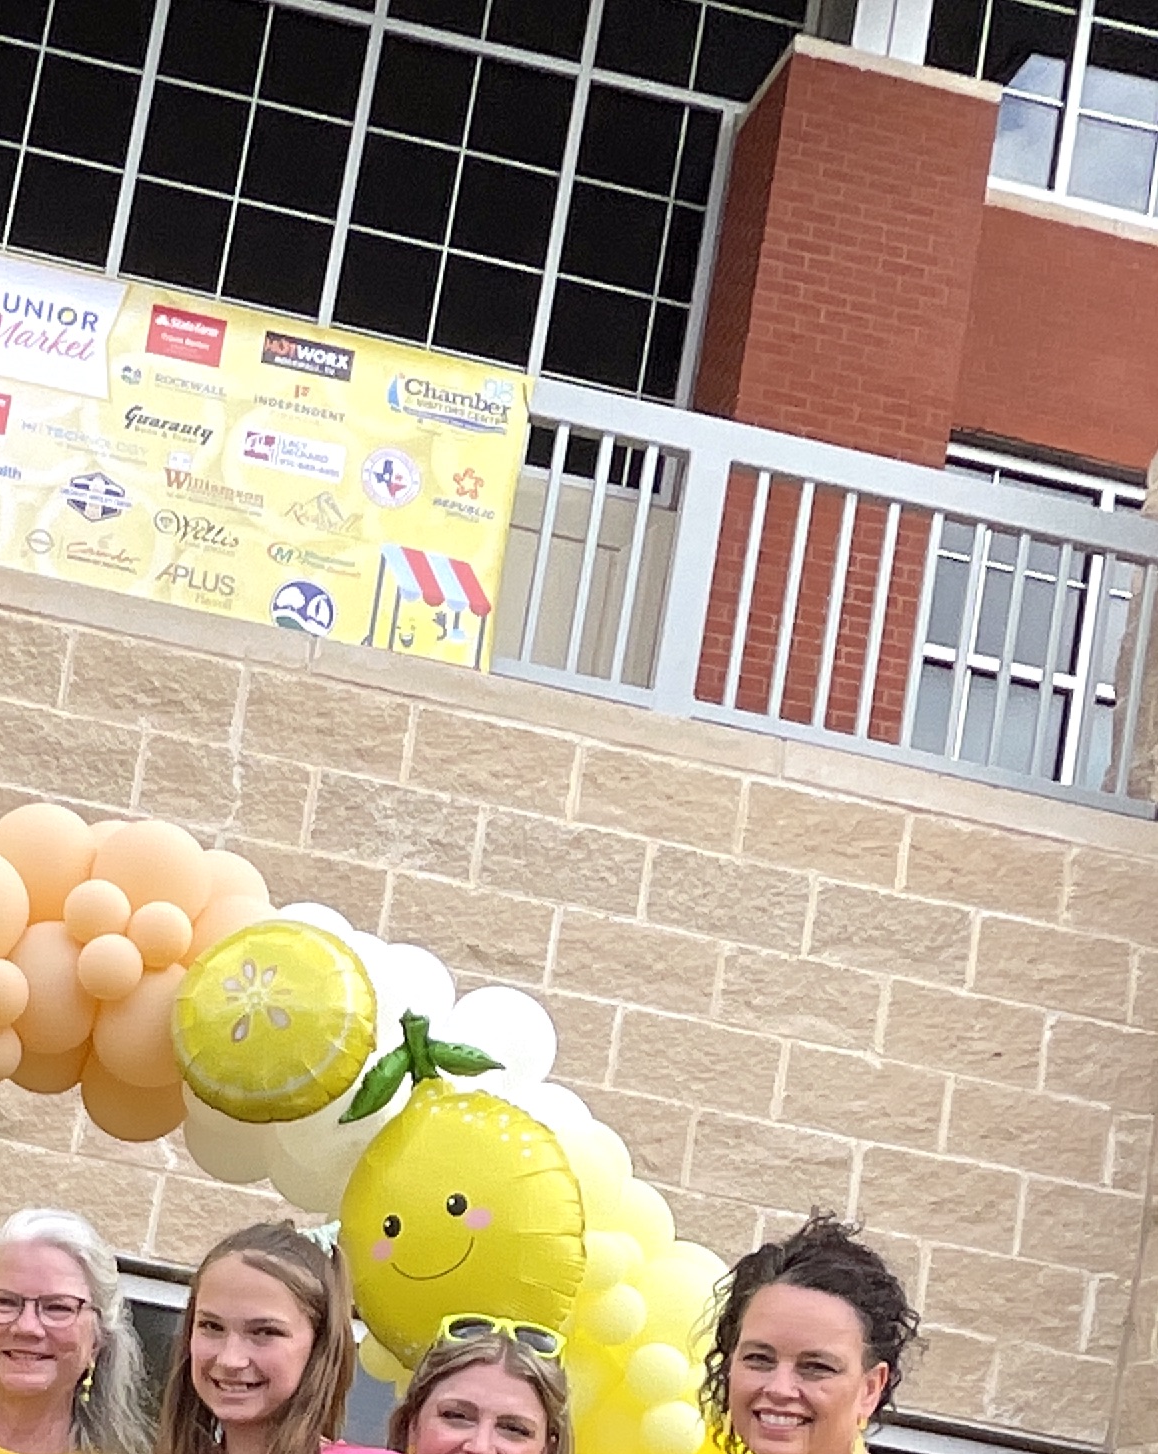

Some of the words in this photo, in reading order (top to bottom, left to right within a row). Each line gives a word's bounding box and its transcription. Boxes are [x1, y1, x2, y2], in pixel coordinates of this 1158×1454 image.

[155, 373, 227, 398] ROCKWALL
[253, 394, 345, 423] INDEPENDENT
[405, 378, 511, 423] Chamber
[124, 404, 213, 446] Guaranty
[433, 497, 495, 520] REPUBLIC
